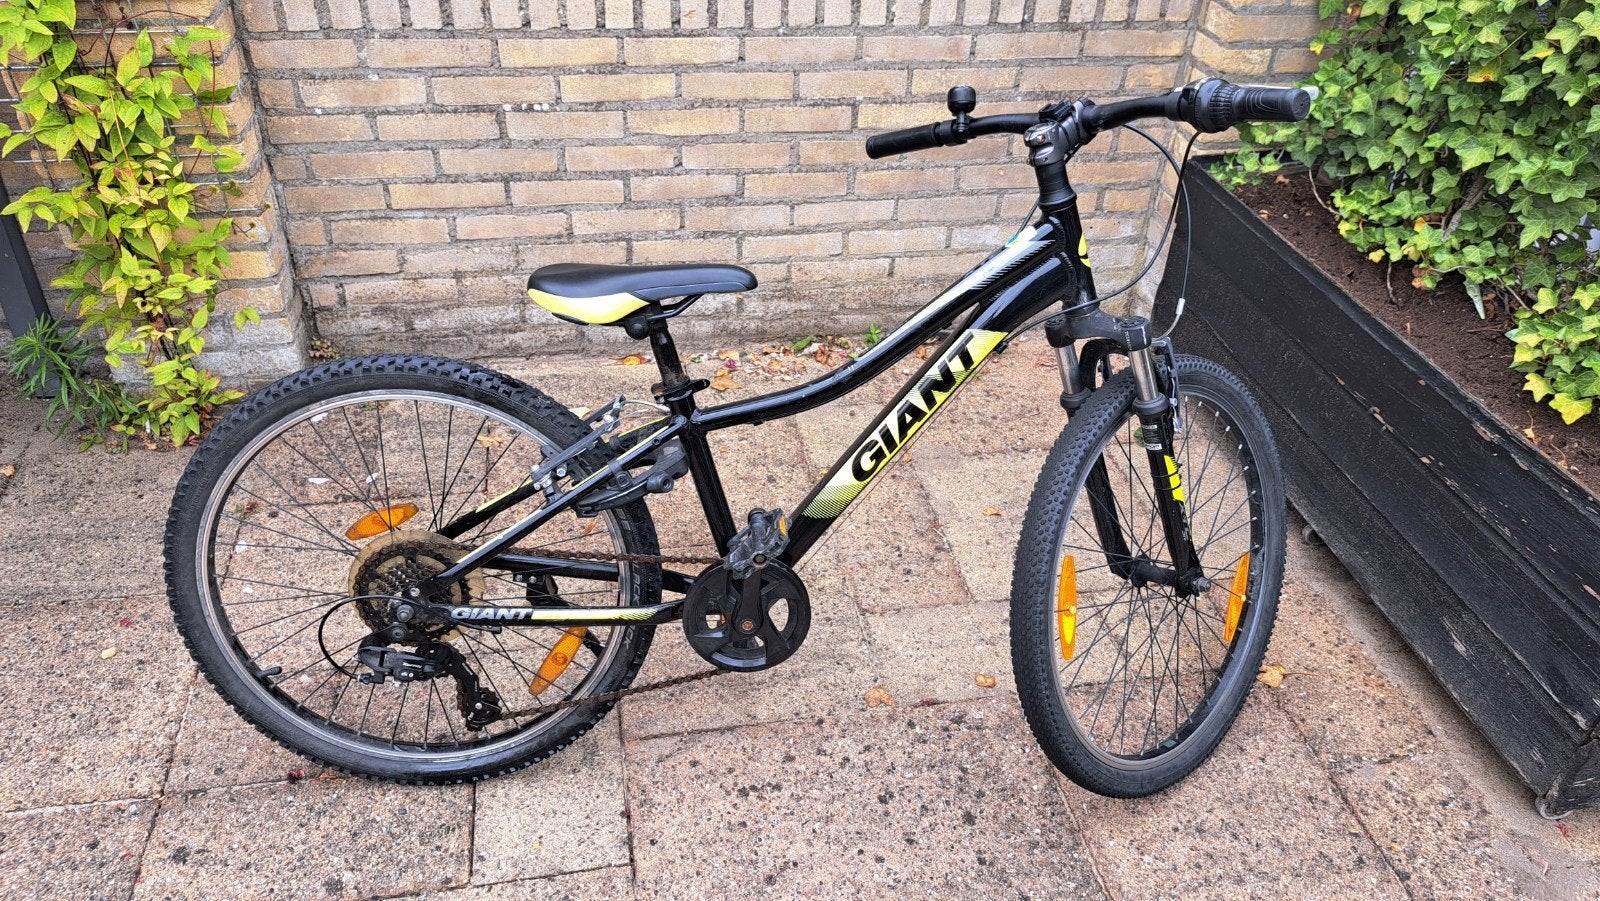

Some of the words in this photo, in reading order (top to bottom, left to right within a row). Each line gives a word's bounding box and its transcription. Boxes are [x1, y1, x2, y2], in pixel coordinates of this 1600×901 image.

[851, 331, 976, 482] GIANT
[632, 560, 641, 606] LACK
[450, 607, 533, 620] GIANT
